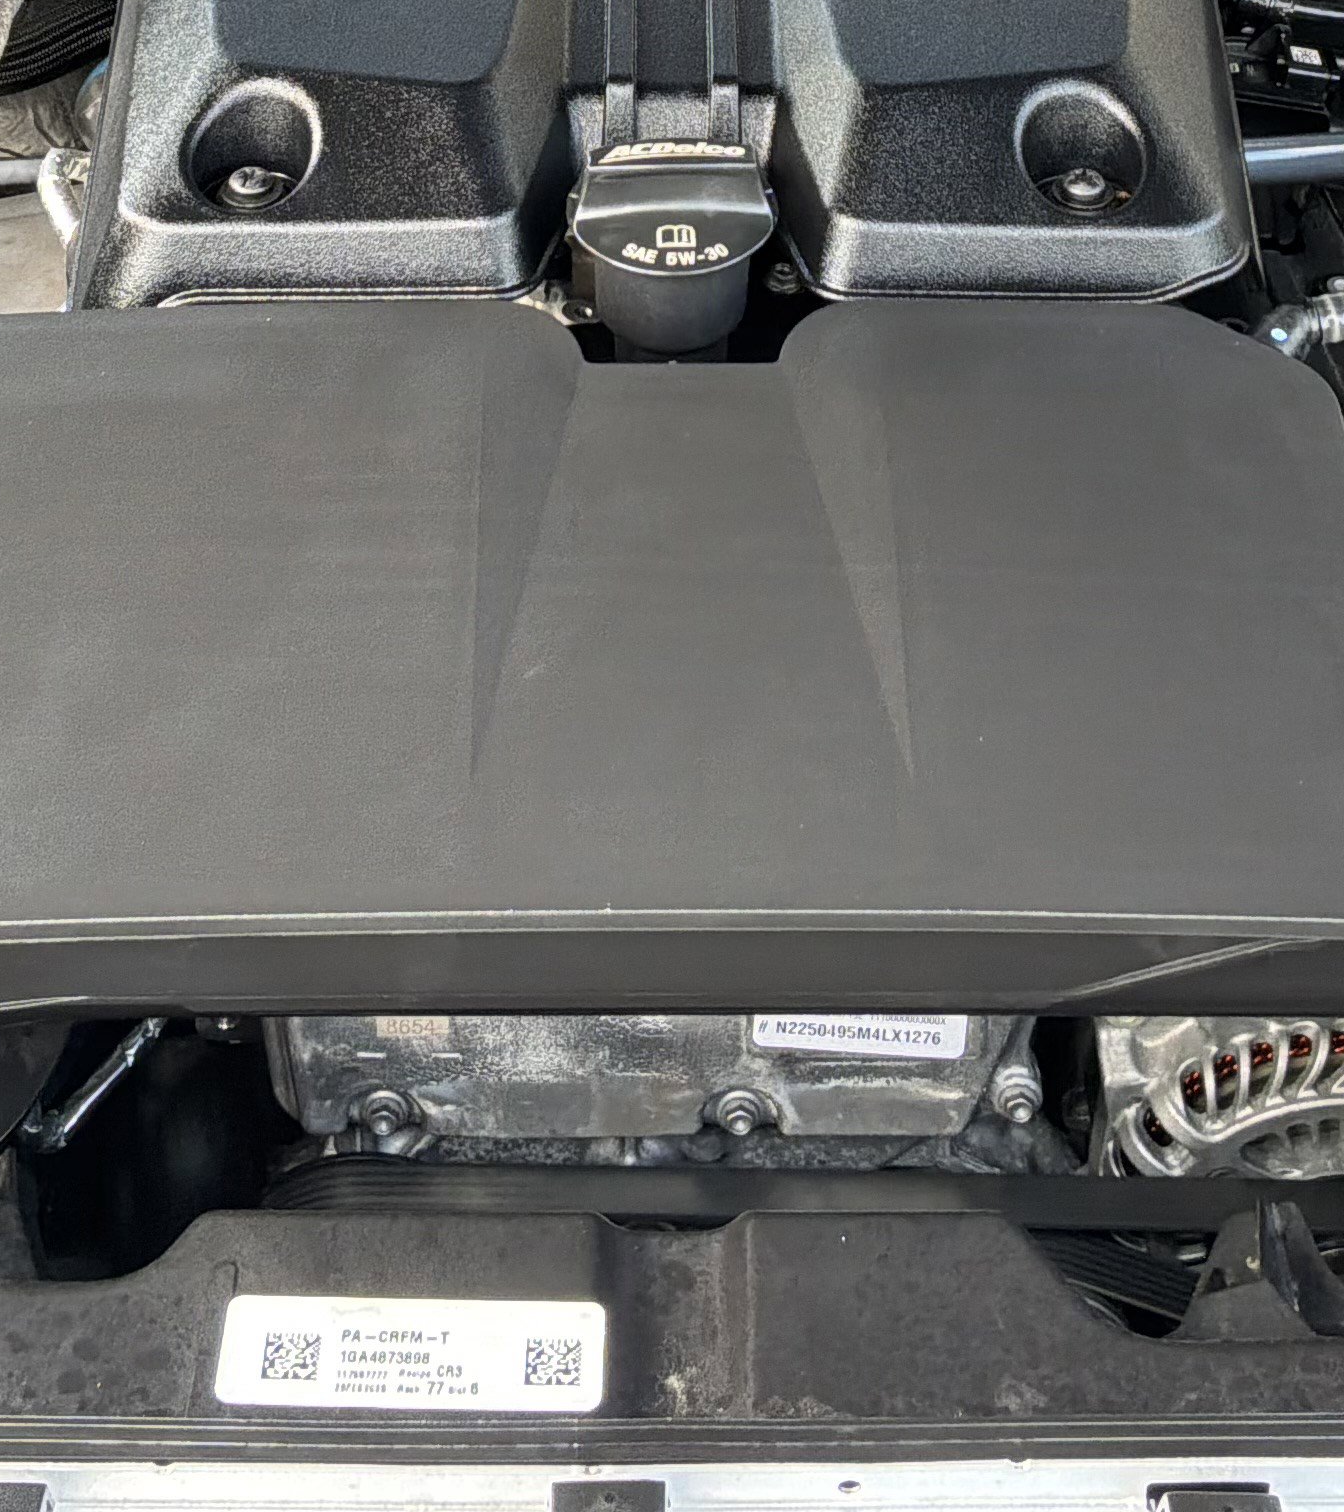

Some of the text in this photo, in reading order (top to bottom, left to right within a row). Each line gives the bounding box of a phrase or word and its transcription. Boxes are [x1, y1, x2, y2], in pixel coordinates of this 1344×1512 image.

[601, 141, 746, 160] ACDelco
[621, 242, 730, 266] SAE 5W-30
[386, 1019, 435, 1035] 8654
